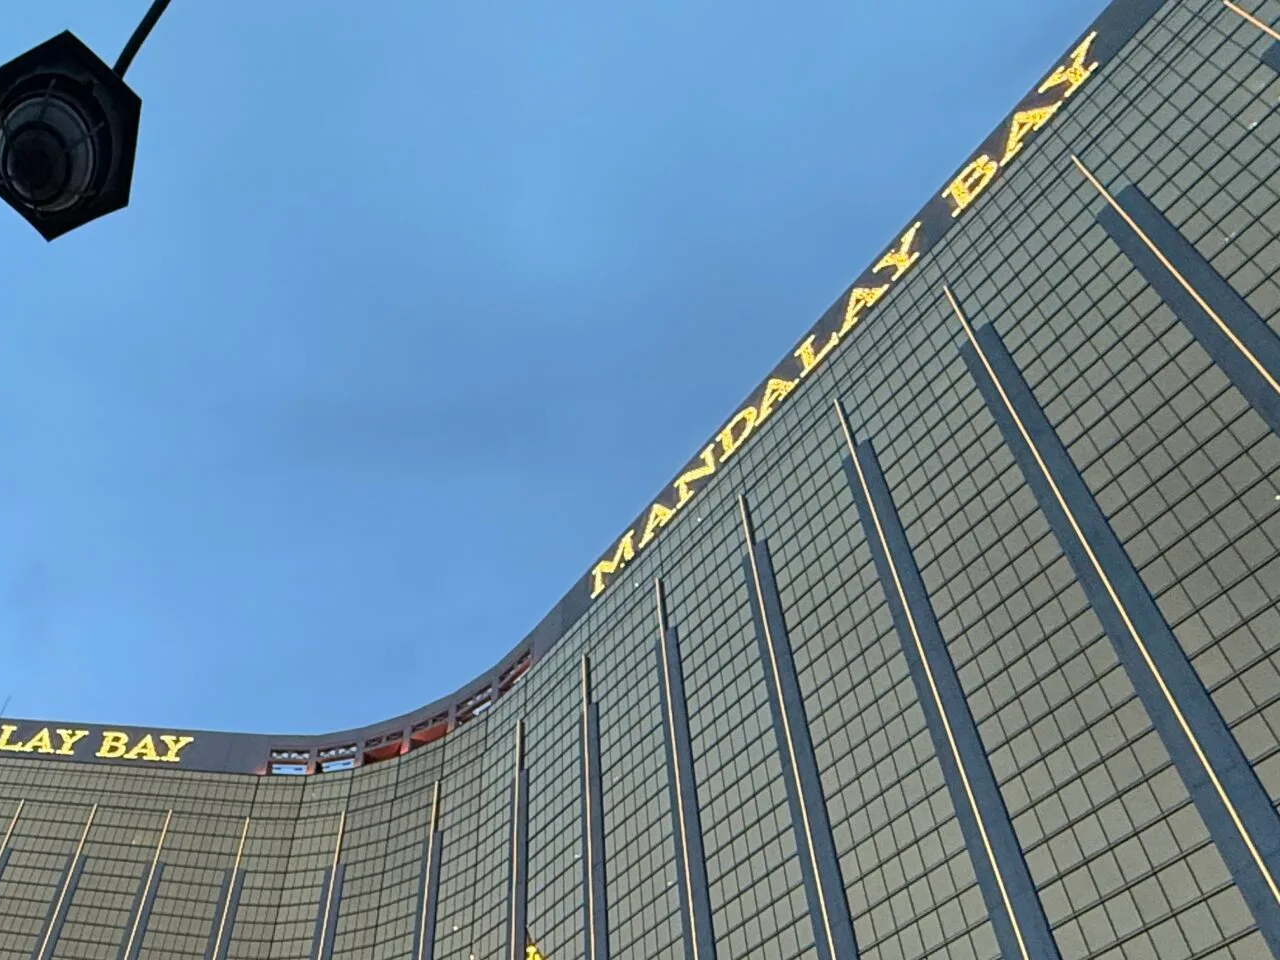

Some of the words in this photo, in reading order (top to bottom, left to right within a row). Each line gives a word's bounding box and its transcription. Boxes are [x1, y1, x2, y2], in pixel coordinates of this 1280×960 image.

[590, 221, 922, 598] MANDALAY
[942, 30, 1099, 217] BAY
[95, 730, 194, 763] BAY
